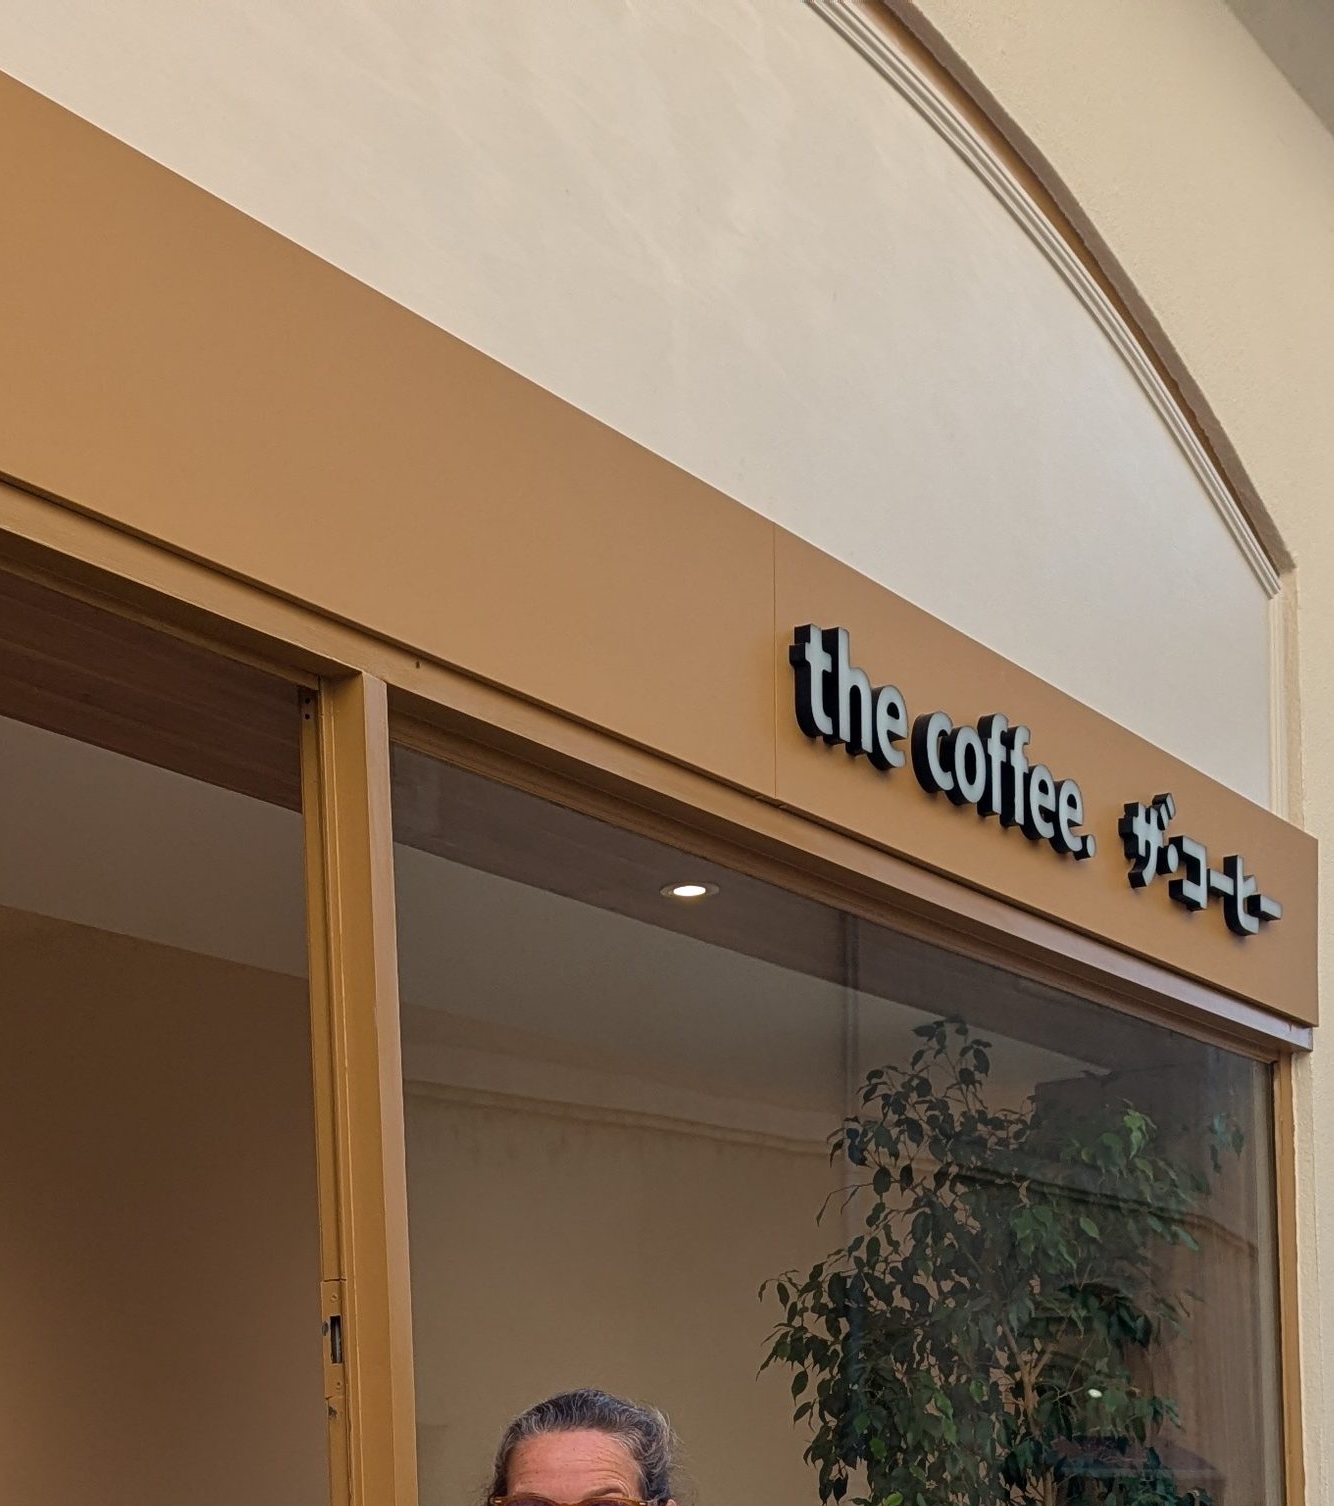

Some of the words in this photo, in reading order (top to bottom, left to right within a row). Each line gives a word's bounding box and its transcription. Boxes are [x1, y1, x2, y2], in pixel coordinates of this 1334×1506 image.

[789, 623, 909, 771] the
[911, 712, 1097, 860] coffee.
[1118, 793, 1283, 936] ザ・コーヒー
